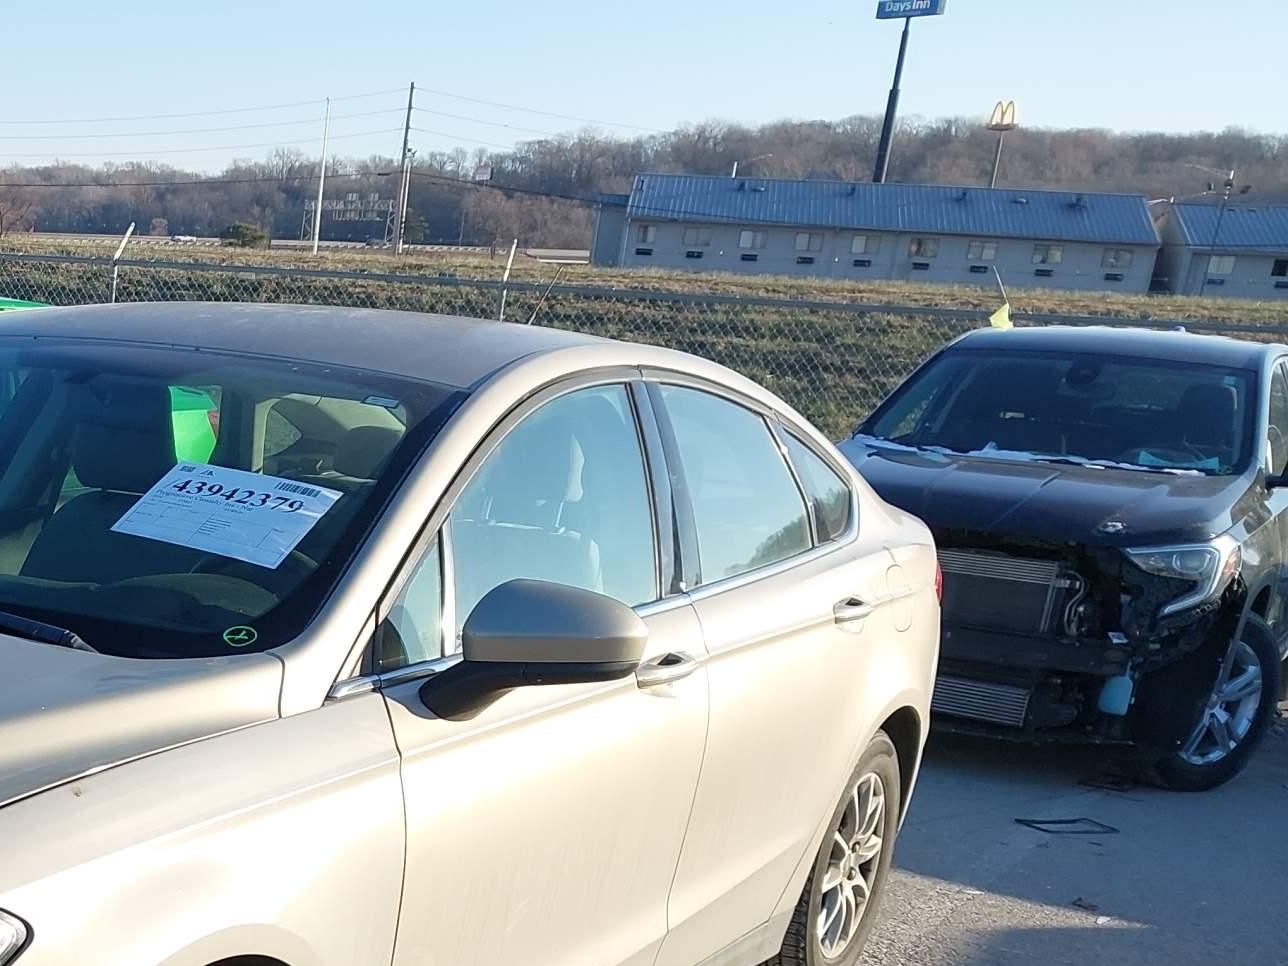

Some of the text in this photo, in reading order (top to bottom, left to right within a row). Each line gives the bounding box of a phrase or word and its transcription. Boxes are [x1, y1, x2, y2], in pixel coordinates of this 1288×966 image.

[885, 0, 930, 12] Days Inn
[172, 479, 305, 513] 43942379
